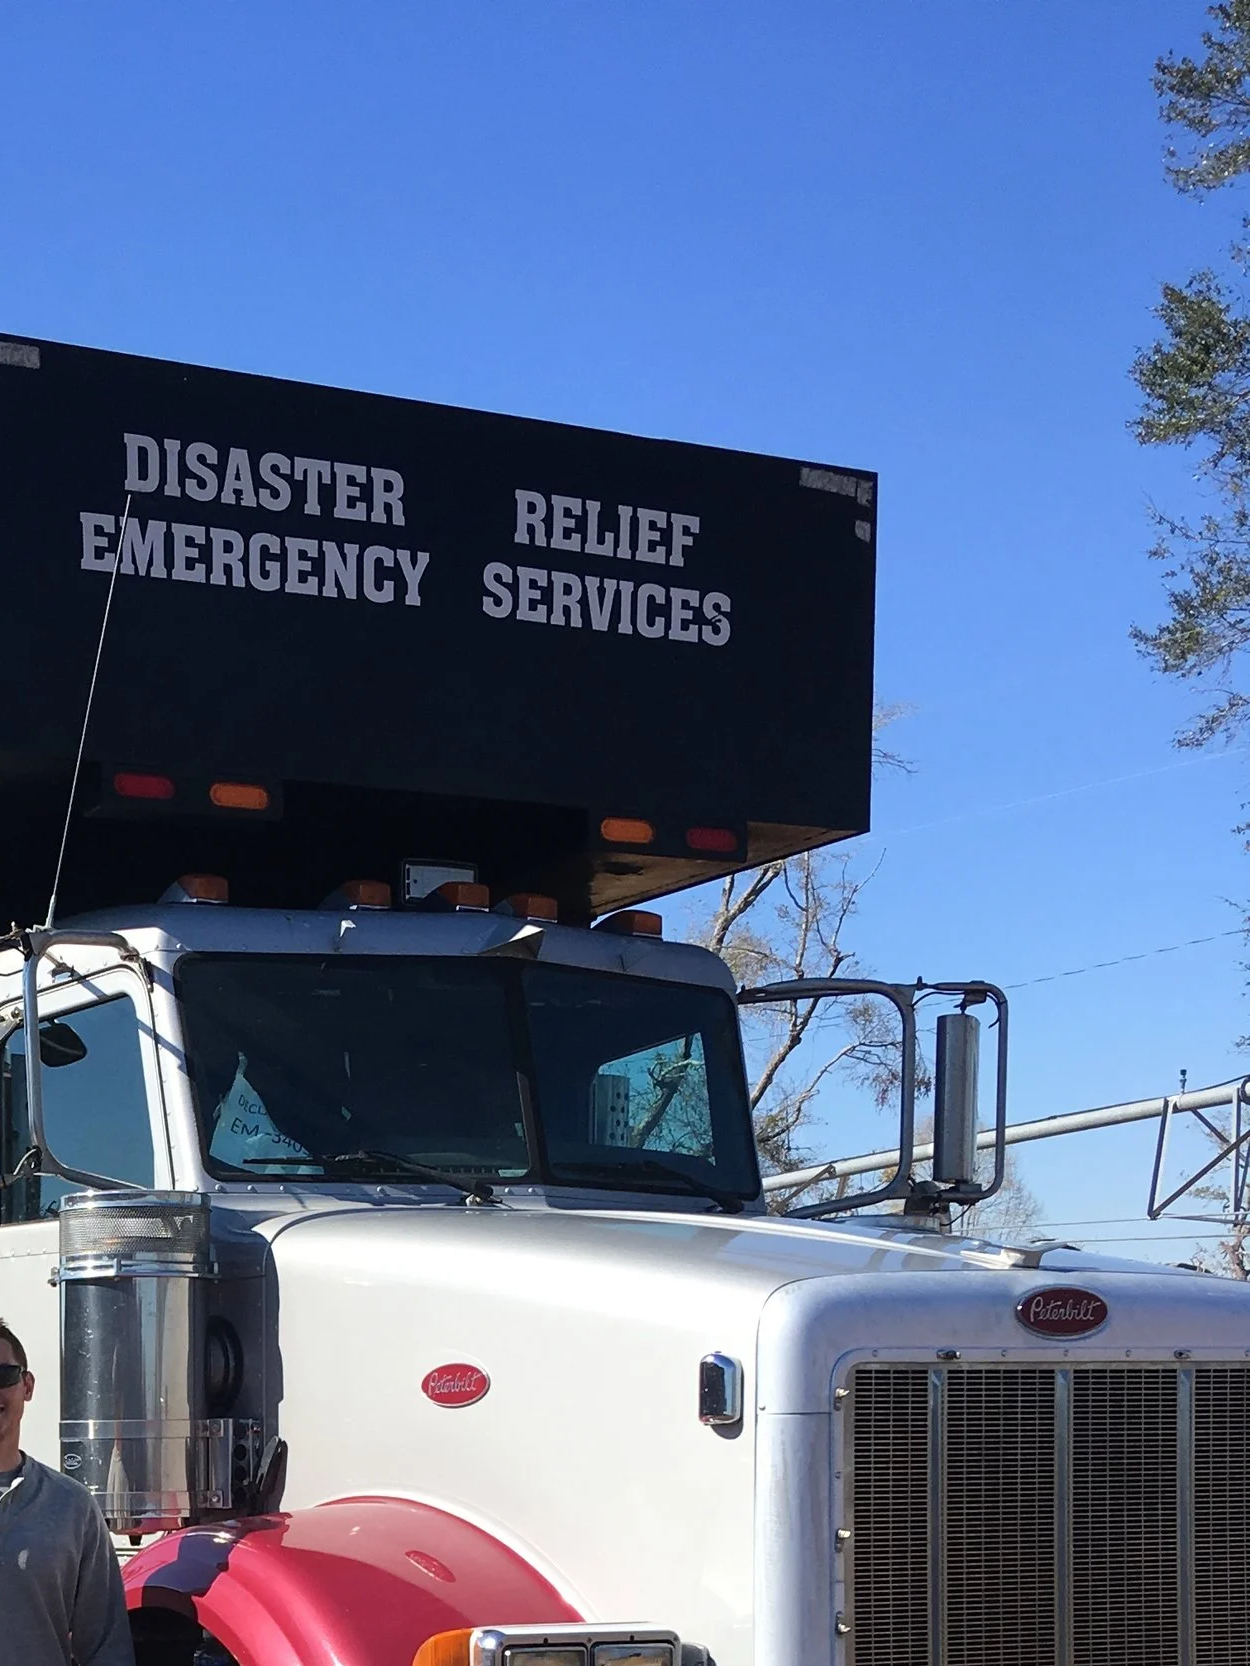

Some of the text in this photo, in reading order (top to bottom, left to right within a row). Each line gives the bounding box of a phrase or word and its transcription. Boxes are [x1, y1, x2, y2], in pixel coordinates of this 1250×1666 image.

[123, 432, 701, 568] DISASTER RELIEF
[79, 511, 733, 648] EMERGENCY SERVICES
[1030, 1296, 1102, 1323] Peterbilt
[428, 1371, 483, 1397] Peterbilt
